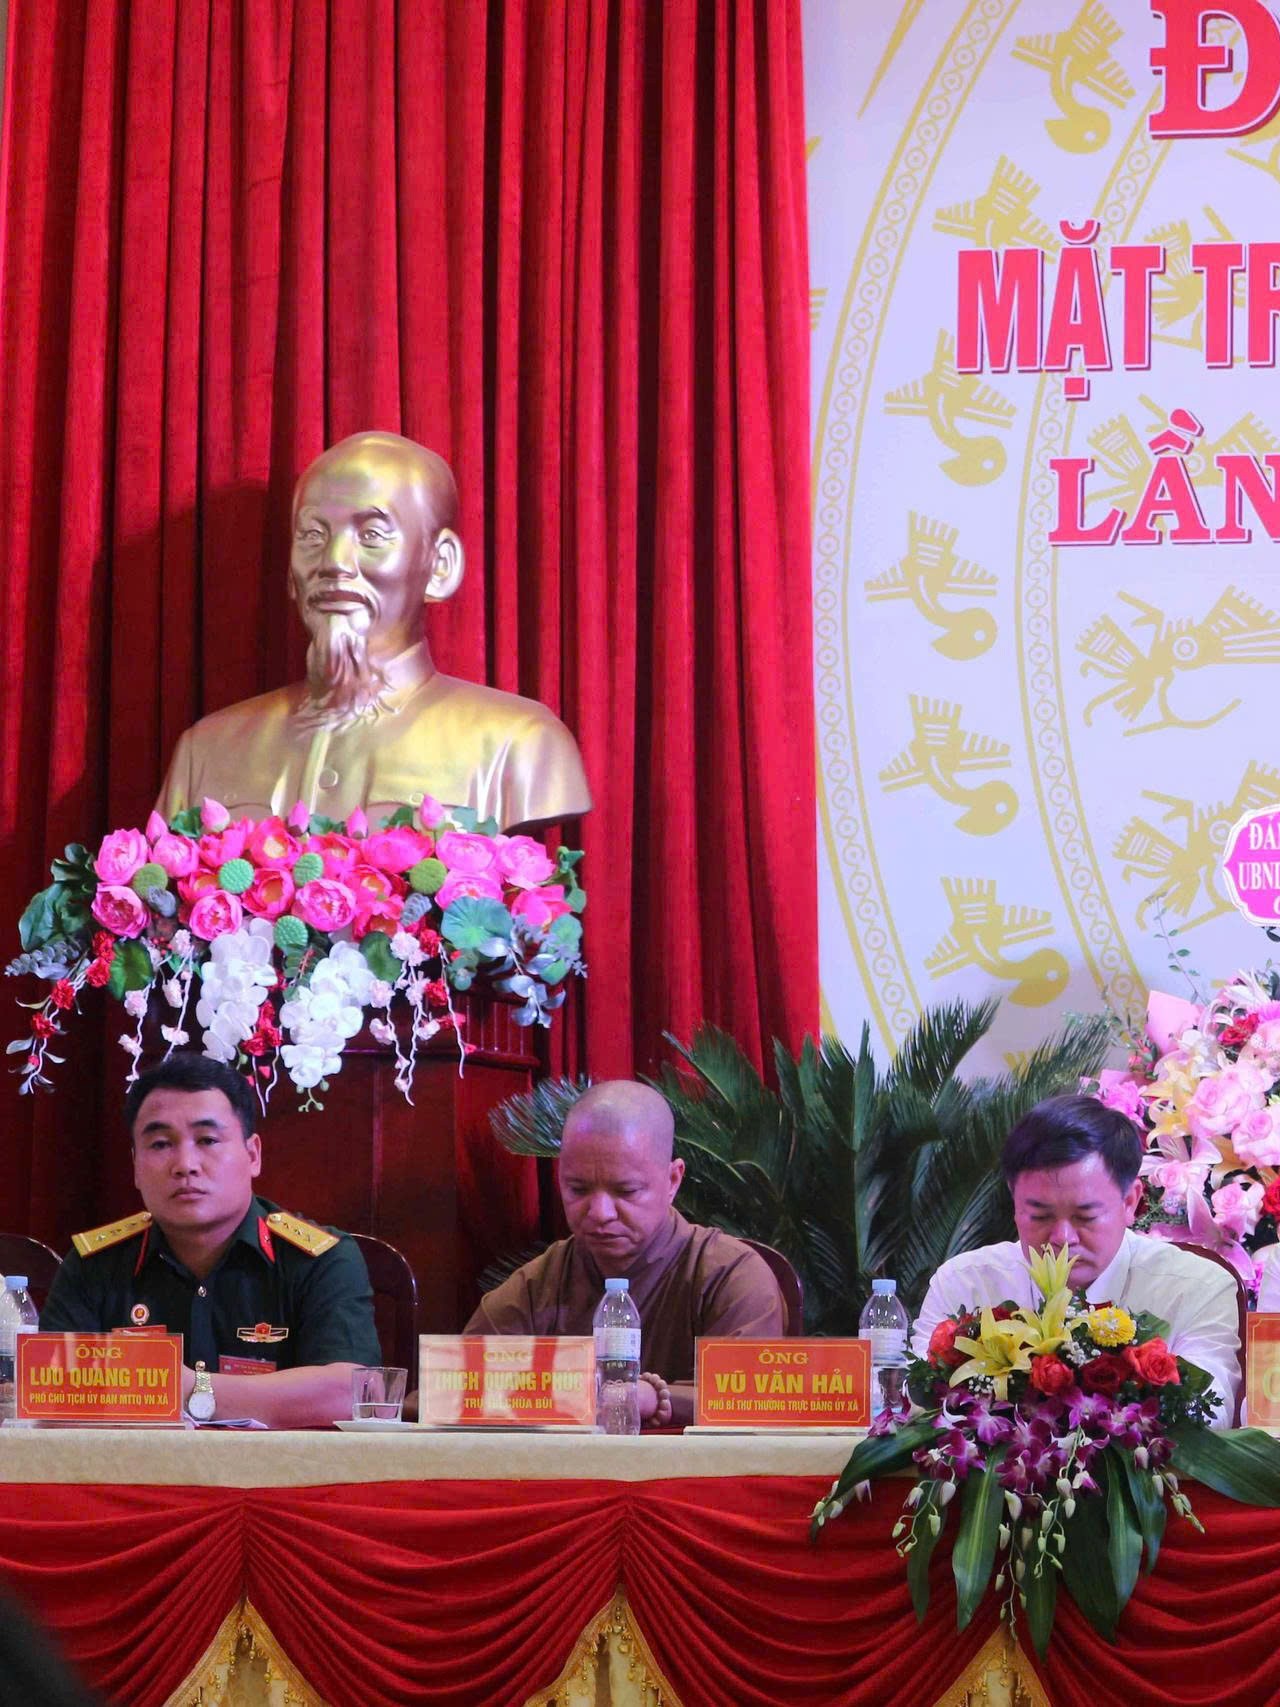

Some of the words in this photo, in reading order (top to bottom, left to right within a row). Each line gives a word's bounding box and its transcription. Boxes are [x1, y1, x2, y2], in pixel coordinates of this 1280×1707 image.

[956, 218, 1165, 400] MẶT
[75, 1344, 123, 1360] ÔNG
[758, 1349, 809, 1364] ÔNG
[715, 1370, 746, 1393] VŨ
[754, 1370, 803, 1394] VĂN
[812, 1368, 853, 1394] HẢI
[100, 1393, 118, 1404] BAN
[119, 1393, 142, 1406] MTTQ
[144, 1393, 155, 1405] VN
